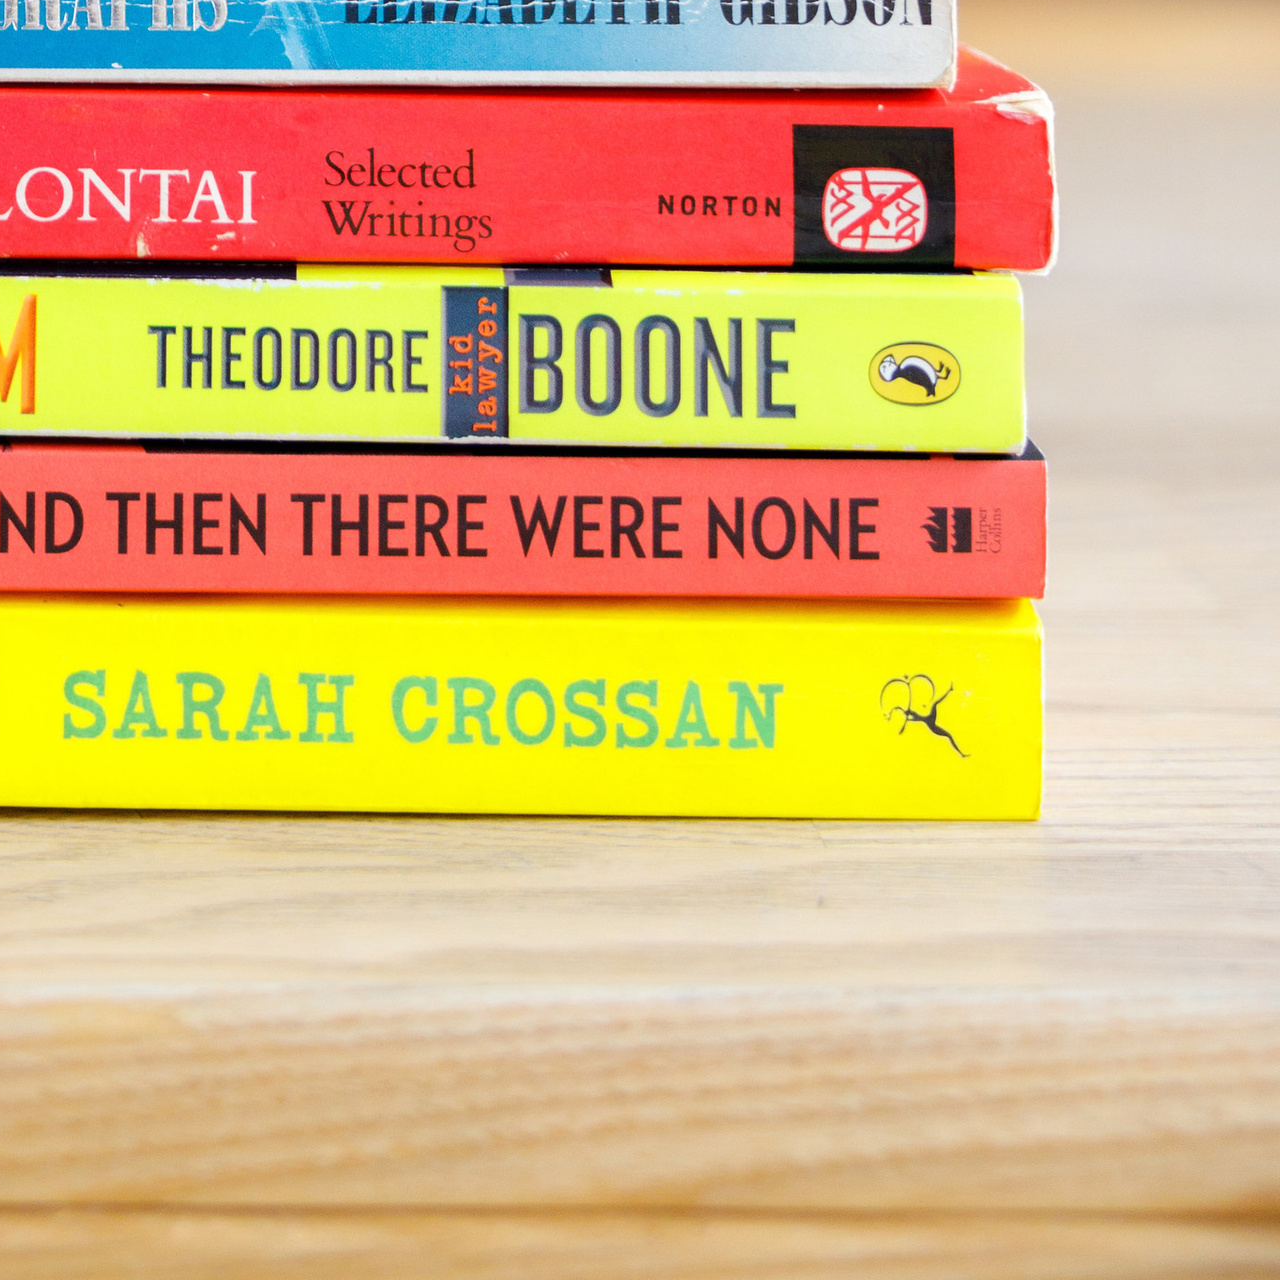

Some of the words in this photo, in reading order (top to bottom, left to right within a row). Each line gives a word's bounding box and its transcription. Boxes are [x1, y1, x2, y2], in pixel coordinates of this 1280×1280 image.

[324, 147, 477, 189] Selected
[321, 200, 493, 253] Writings
[657, 194, 783, 218] NORTON
[147, 325, 429, 393] THEODORE
[448, 333, 473, 395] kid
[472, 296, 503, 432] lawyer
[518, 313, 798, 419] BOONE
[106, 492, 268, 556] THEN
[290, 493, 489, 557] THERE
[510, 495, 683, 559] WERE
[707, 497, 880, 561] NONE
[975, 507, 991, 553] Harper
[988, 507, 1003, 554] Collins
[62, 668, 356, 744] SARAH
[391, 675, 784, 749] CROSSAN
